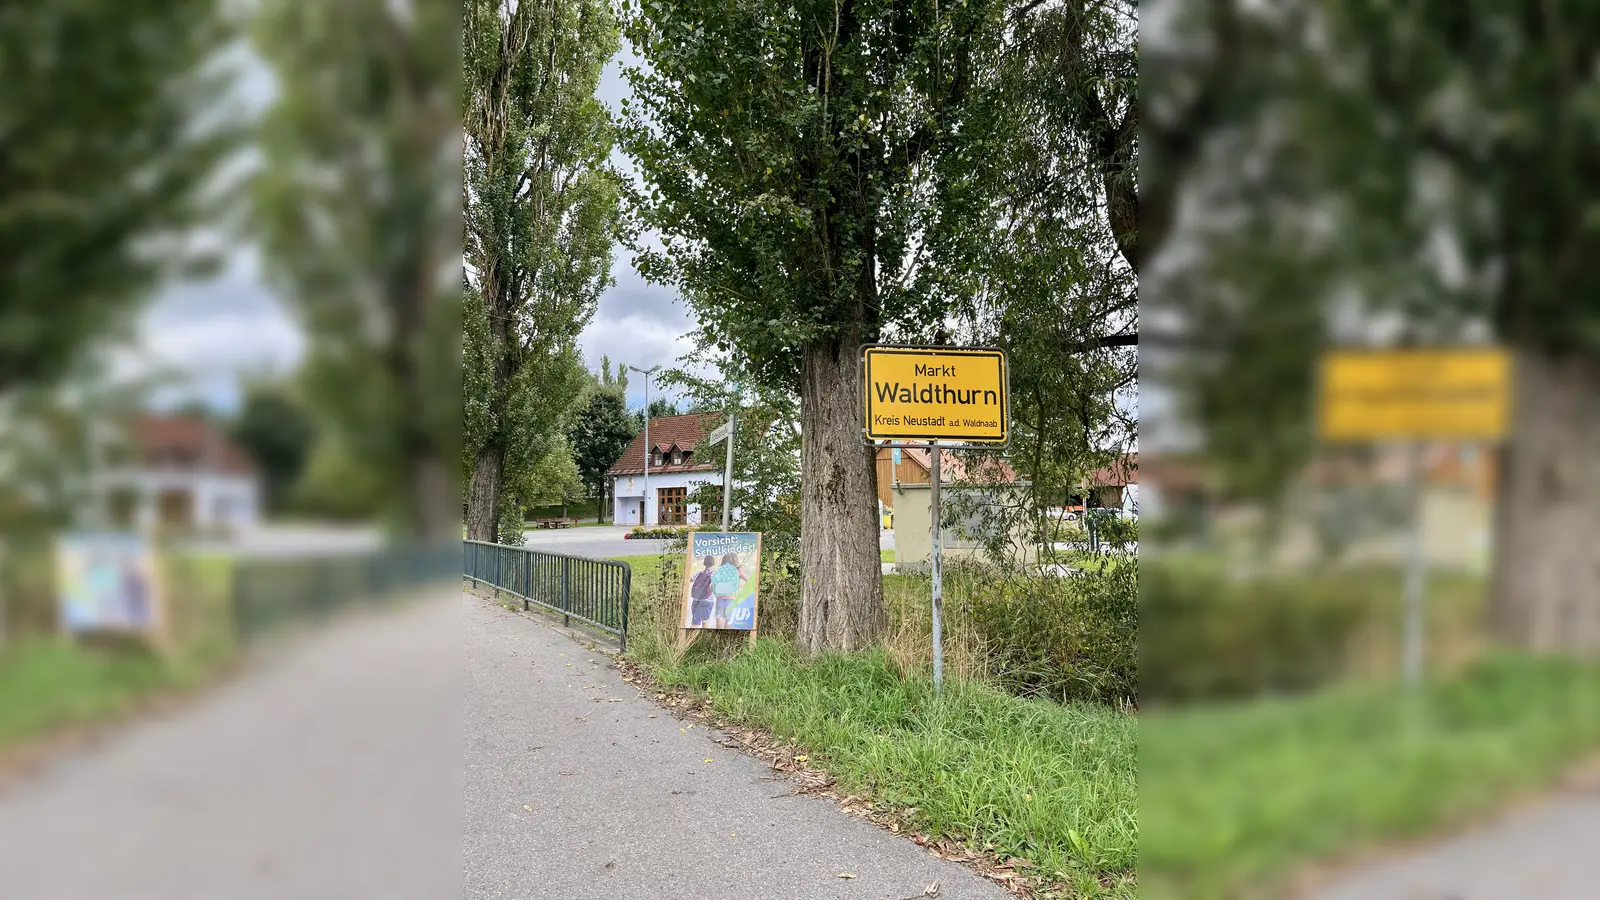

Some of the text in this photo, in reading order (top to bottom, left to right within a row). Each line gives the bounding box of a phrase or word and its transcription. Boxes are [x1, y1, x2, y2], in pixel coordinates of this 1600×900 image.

[915, 363, 956, 377] Markt
[874, 381, 997, 405] Waldthurn
[874, 414, 900, 426] Kreis
[903, 415, 946, 427] Neustadt
[963, 419, 998, 428] Waldnaab
[695, 536, 738, 547] Vorsicht:
[695, 543, 756, 557] Schulkinder!
